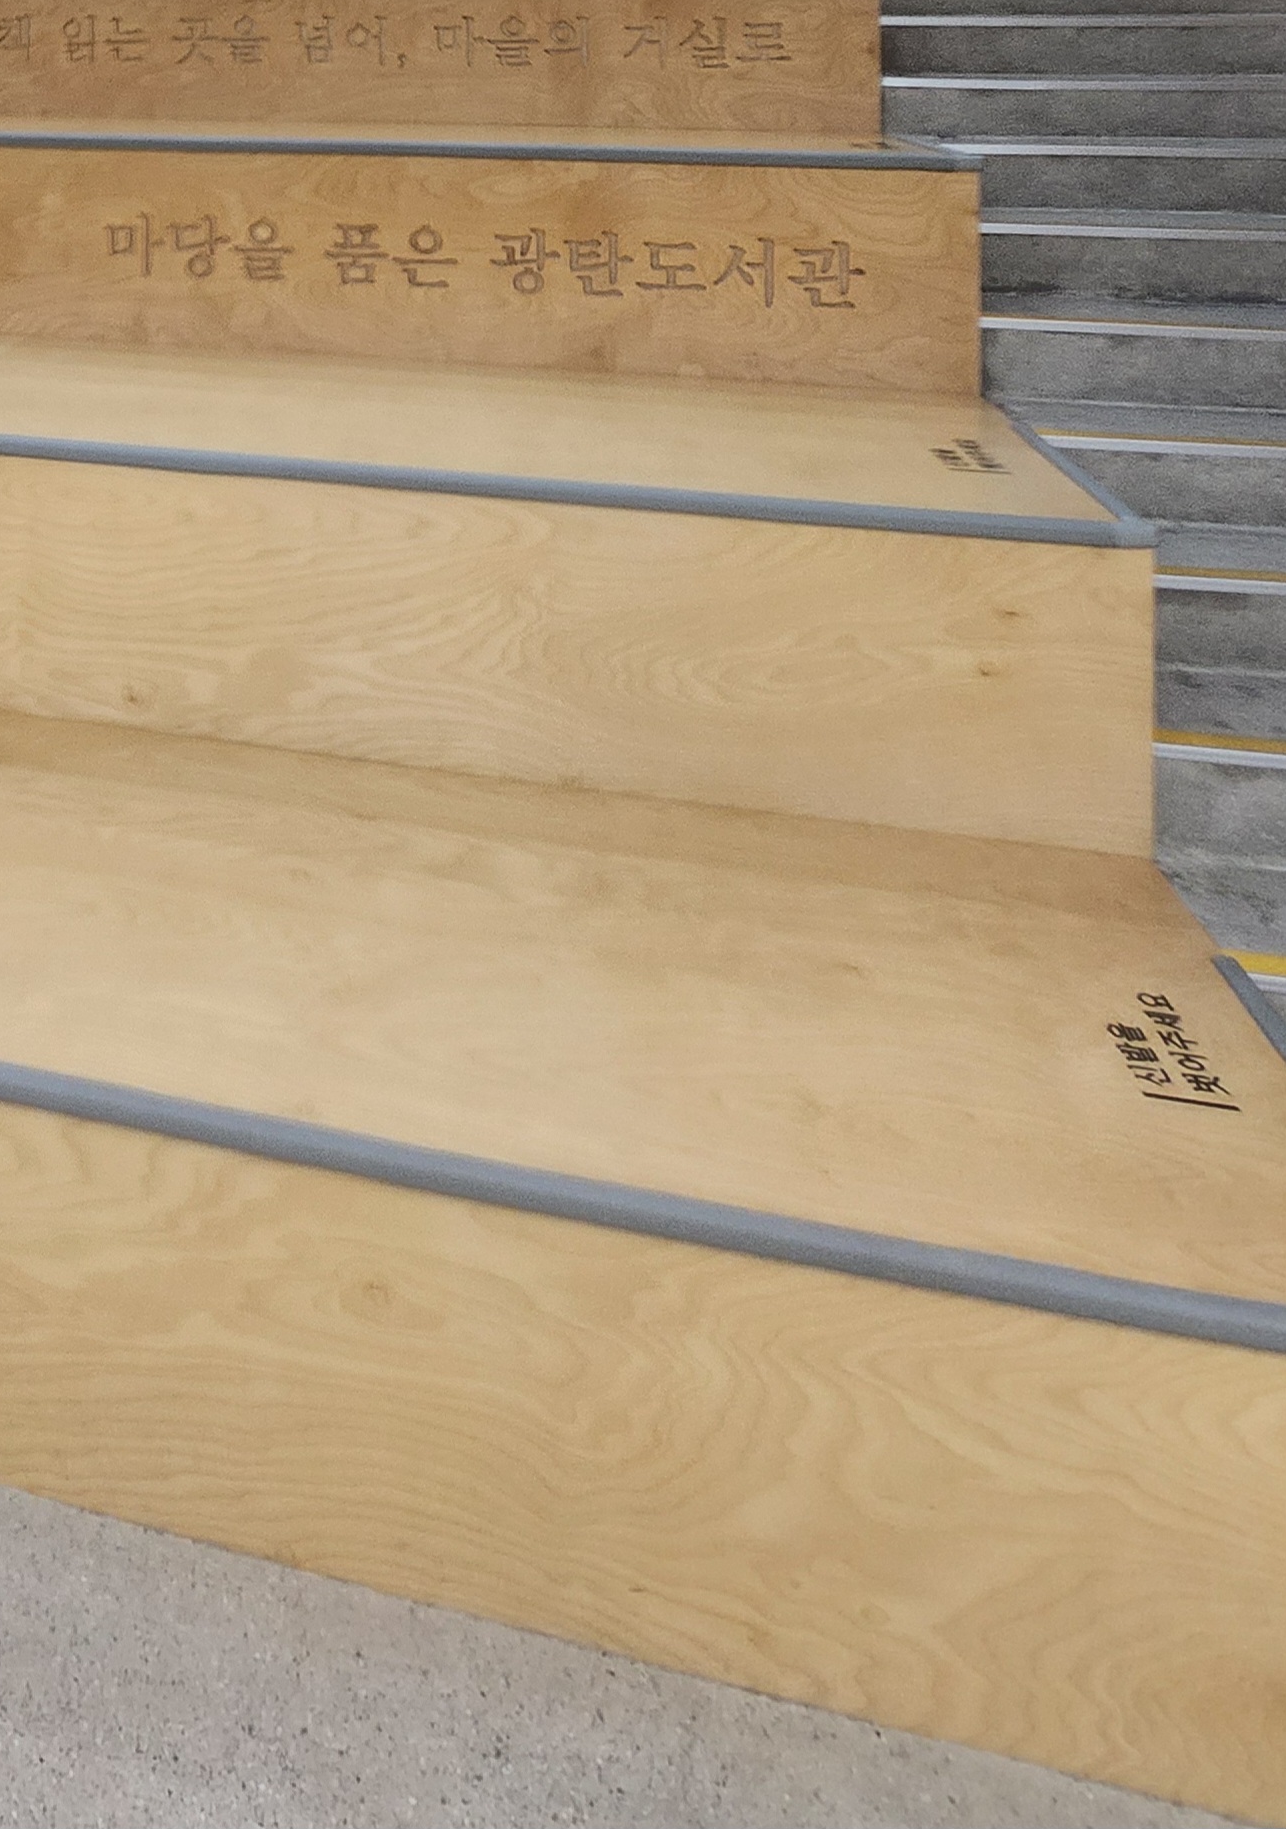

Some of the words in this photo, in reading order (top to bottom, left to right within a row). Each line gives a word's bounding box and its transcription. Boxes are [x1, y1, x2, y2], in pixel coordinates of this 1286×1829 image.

[63, 13, 149, 64] 읽는
[295, 14, 406, 69] 넘어,
[433, 15, 590, 67] 마을의
[623, 15, 792, 69] 거실로
[104, 212, 295, 281] 마당을
[323, 221, 459, 288] 품은
[489, 227, 866, 310] 광탄도서관
[1107, 1022, 1171, 1086] 신발을
[1136, 991, 1232, 1096] 벗어주세요
